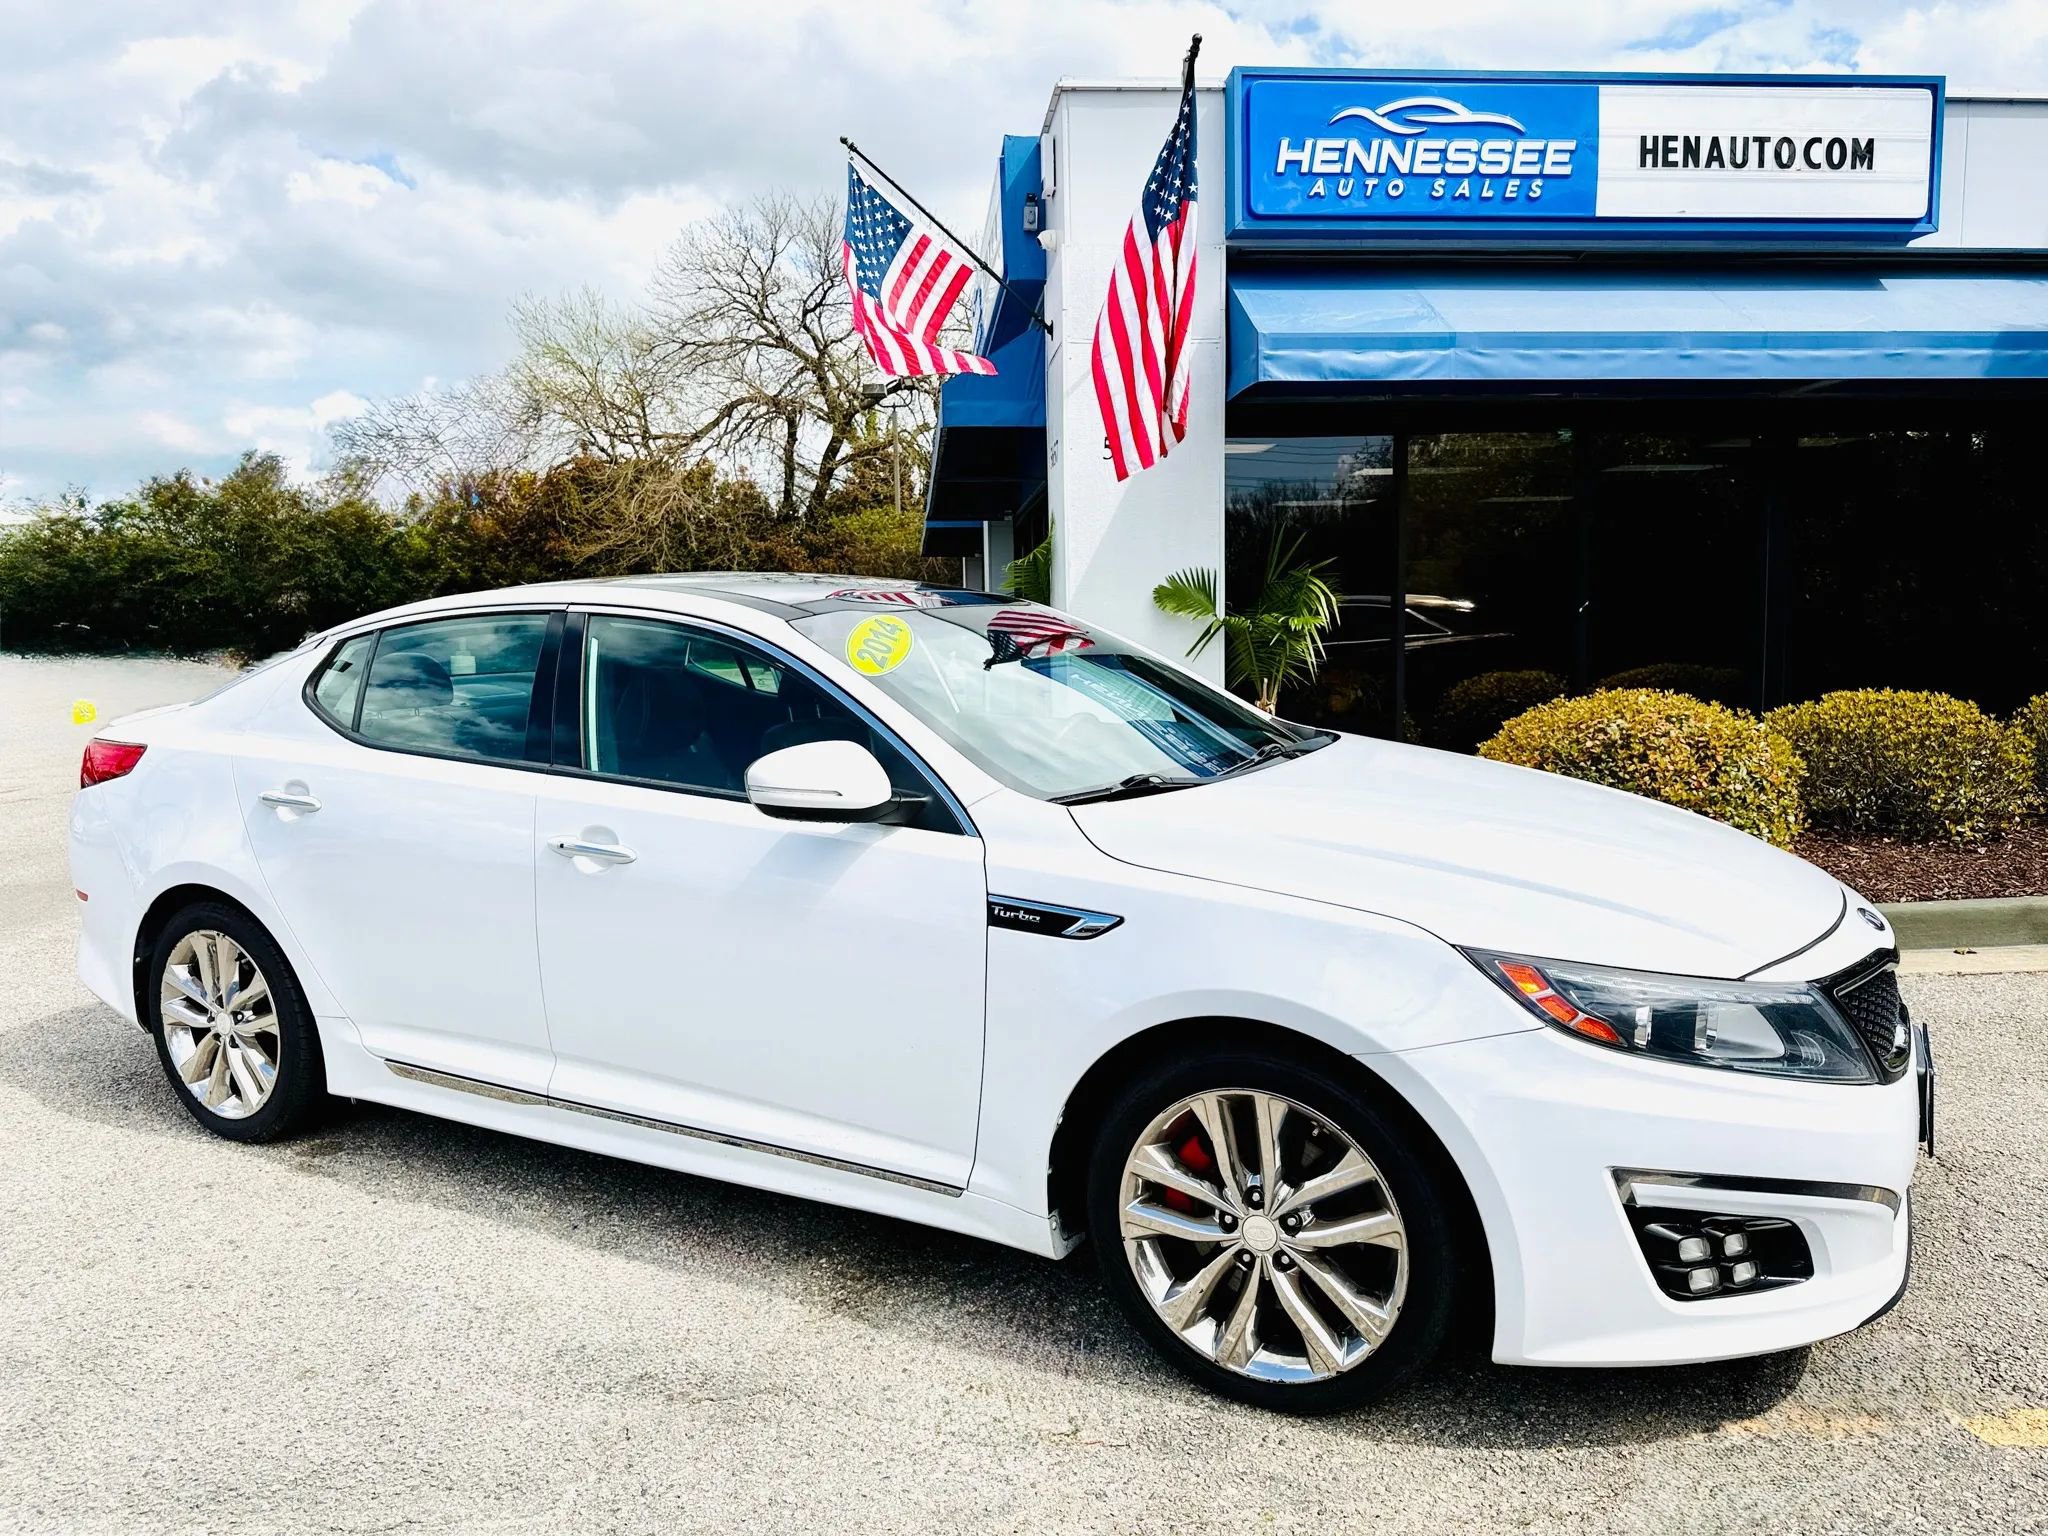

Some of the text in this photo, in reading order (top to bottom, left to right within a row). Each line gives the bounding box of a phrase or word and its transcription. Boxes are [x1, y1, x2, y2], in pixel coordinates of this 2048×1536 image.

[1275, 138, 1576, 176] HENNESSEE
[1308, 178, 1544, 199] AUTO SALES
[857, 618, 903, 669] 2014
[991, 905, 1041, 923] Turbo
